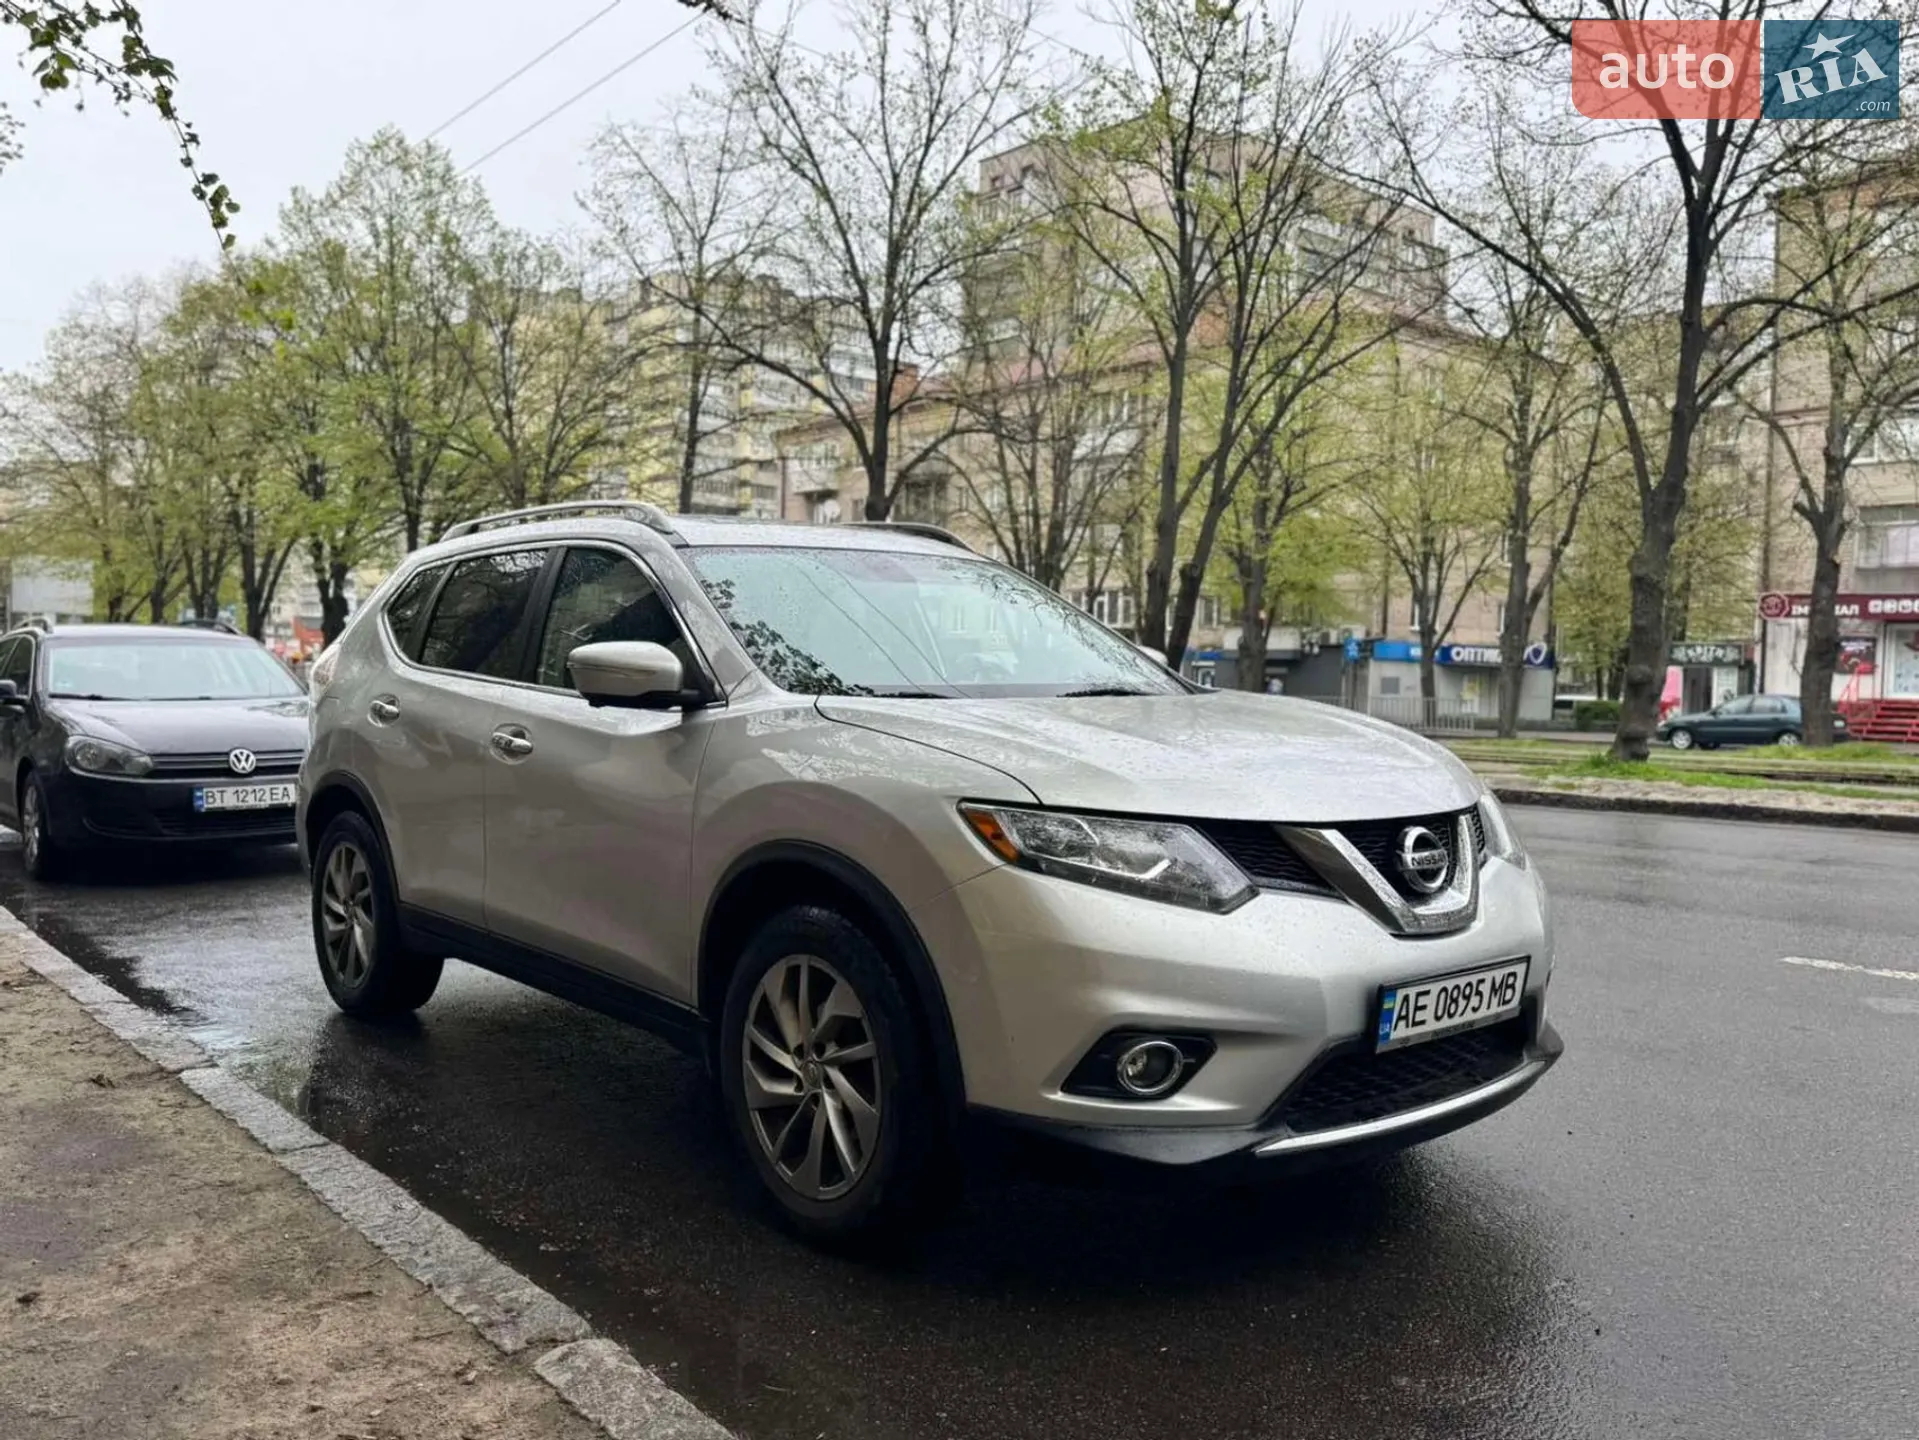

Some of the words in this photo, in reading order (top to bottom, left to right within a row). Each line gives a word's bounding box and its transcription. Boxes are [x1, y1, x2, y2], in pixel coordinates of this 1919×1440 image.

[205, 790, 228, 805] BT
[233, 787, 267, 803] 1212
[270, 786, 292, 802] EA
[1393, 989, 1431, 1032] AE
[1434, 977, 1486, 1022] 0895
[1485, 970, 1519, 1011] MB
